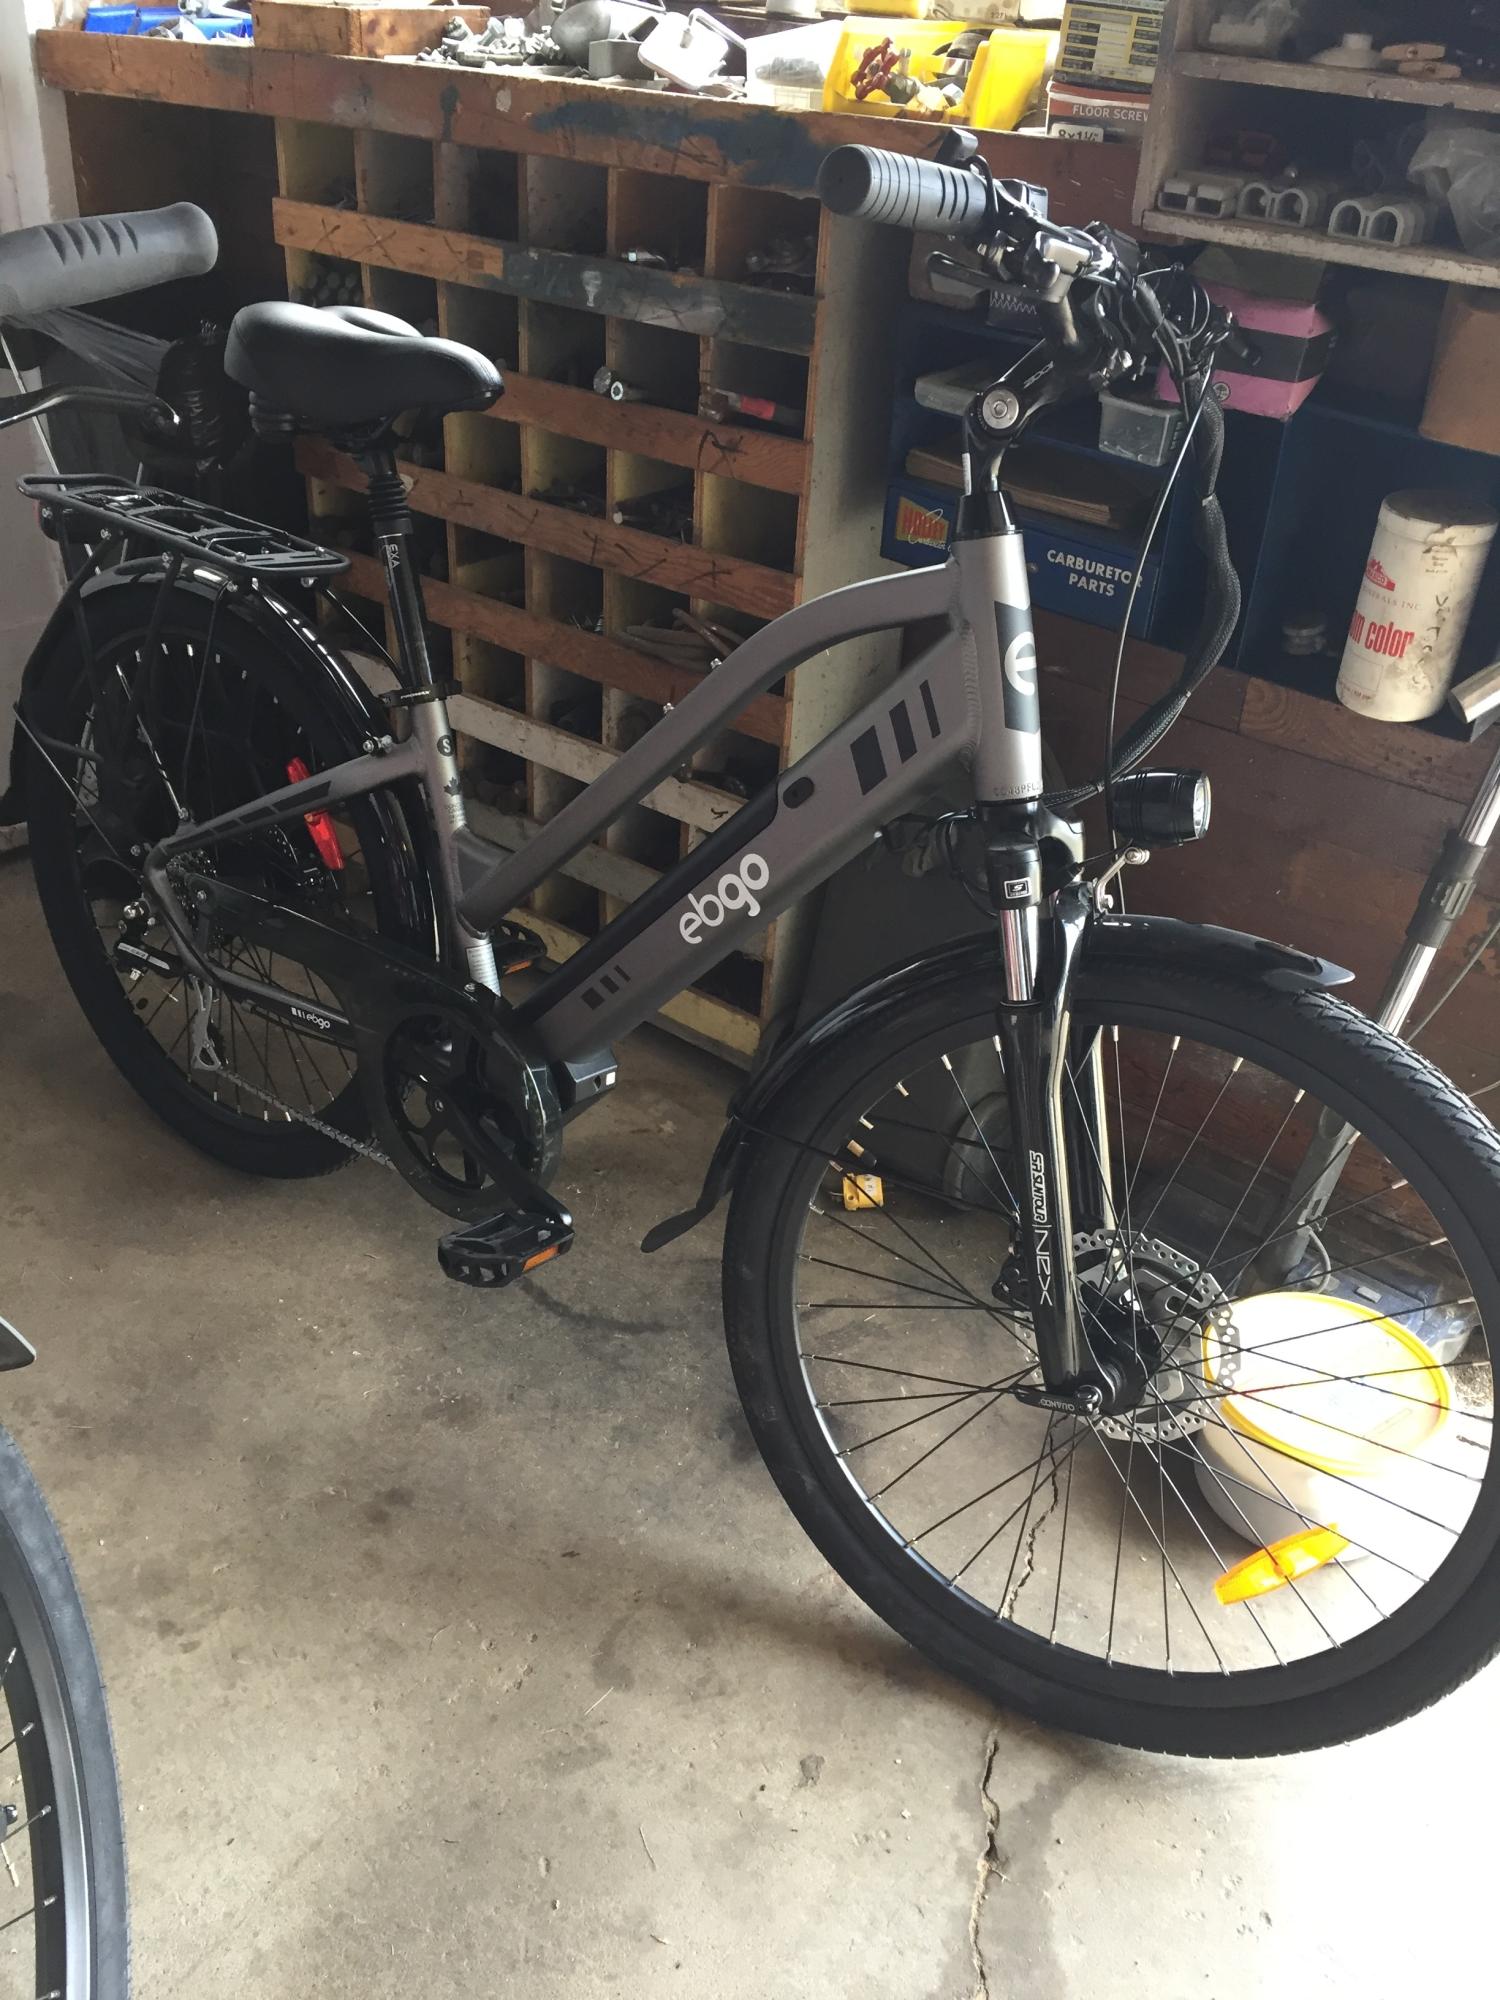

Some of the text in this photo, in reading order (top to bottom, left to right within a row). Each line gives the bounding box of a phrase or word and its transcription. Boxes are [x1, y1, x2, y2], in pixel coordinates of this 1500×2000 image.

[1072, 104, 1110, 118] FLOOR
[1068, 572, 1116, 598] PARTS
[1364, 619, 1416, 659] color
[679, 853, 770, 945] ebgo
[306, 1013, 331, 1030] ebgo
[1032, 1172, 1048, 1224] SUNTOUR
